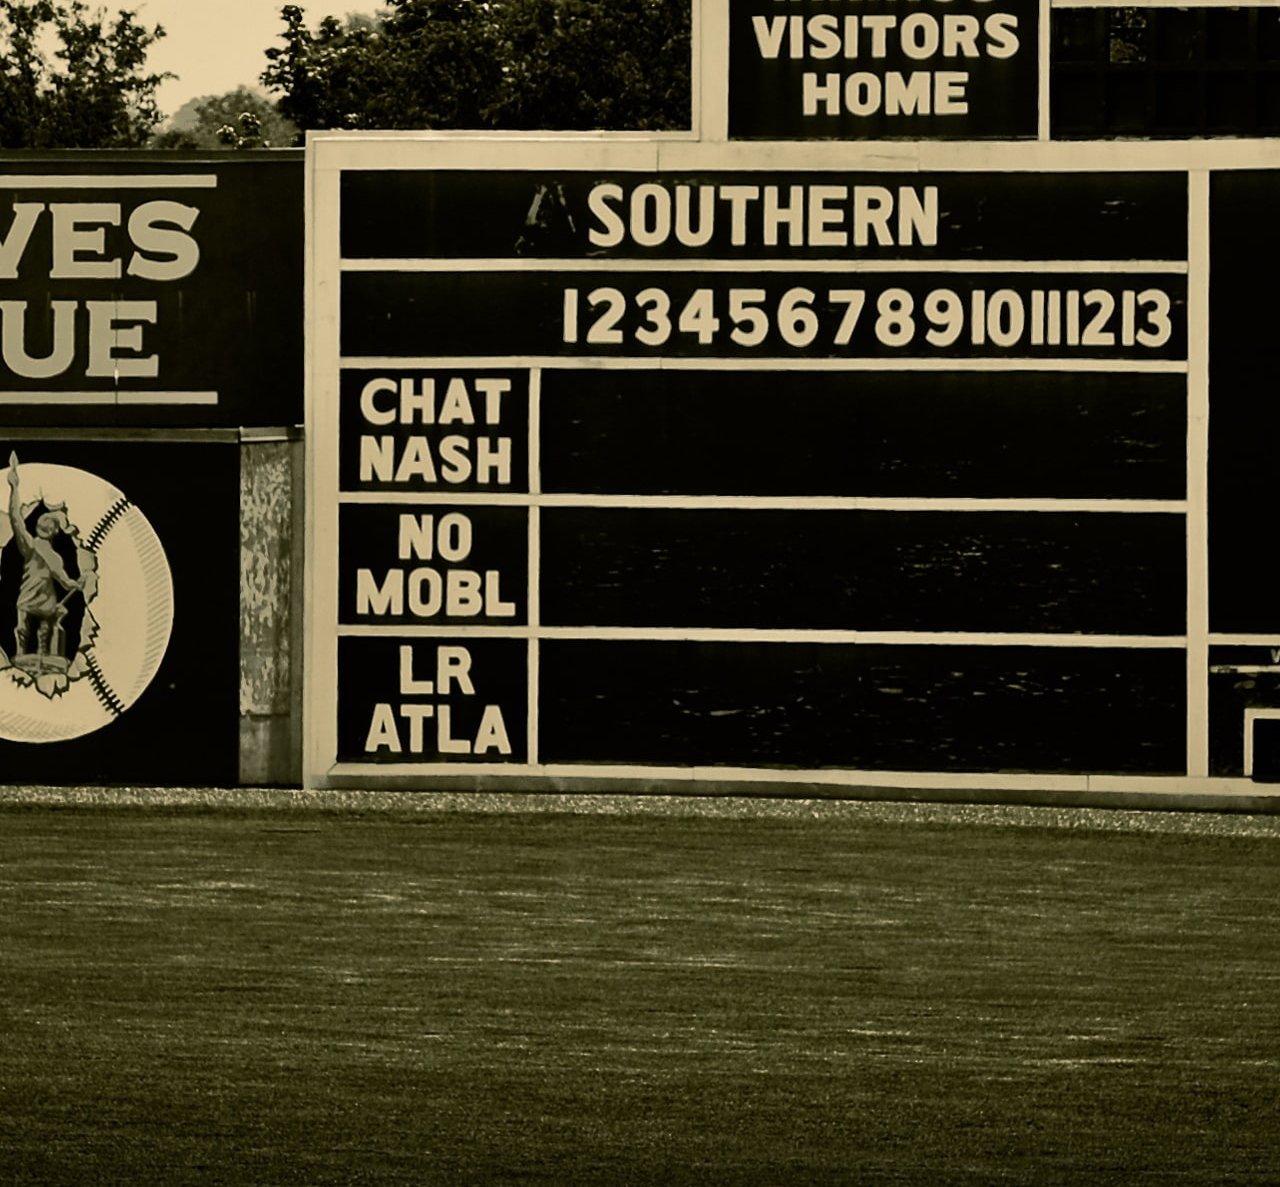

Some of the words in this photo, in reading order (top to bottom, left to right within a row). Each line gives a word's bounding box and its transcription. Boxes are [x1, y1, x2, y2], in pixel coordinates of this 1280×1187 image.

[751, 12, 1020, 60] VISITORS
[802, 70, 969, 117] HOME
[587, 182, 939, 248] SOUTHERN
[359, 377, 512, 426] CHAT
[359, 434, 512, 485] NASH
[398, 512, 473, 563] NO
[356, 567, 516, 618] MOBL
[399, 645, 476, 695] LR
[364, 703, 512, 755] ATLA
